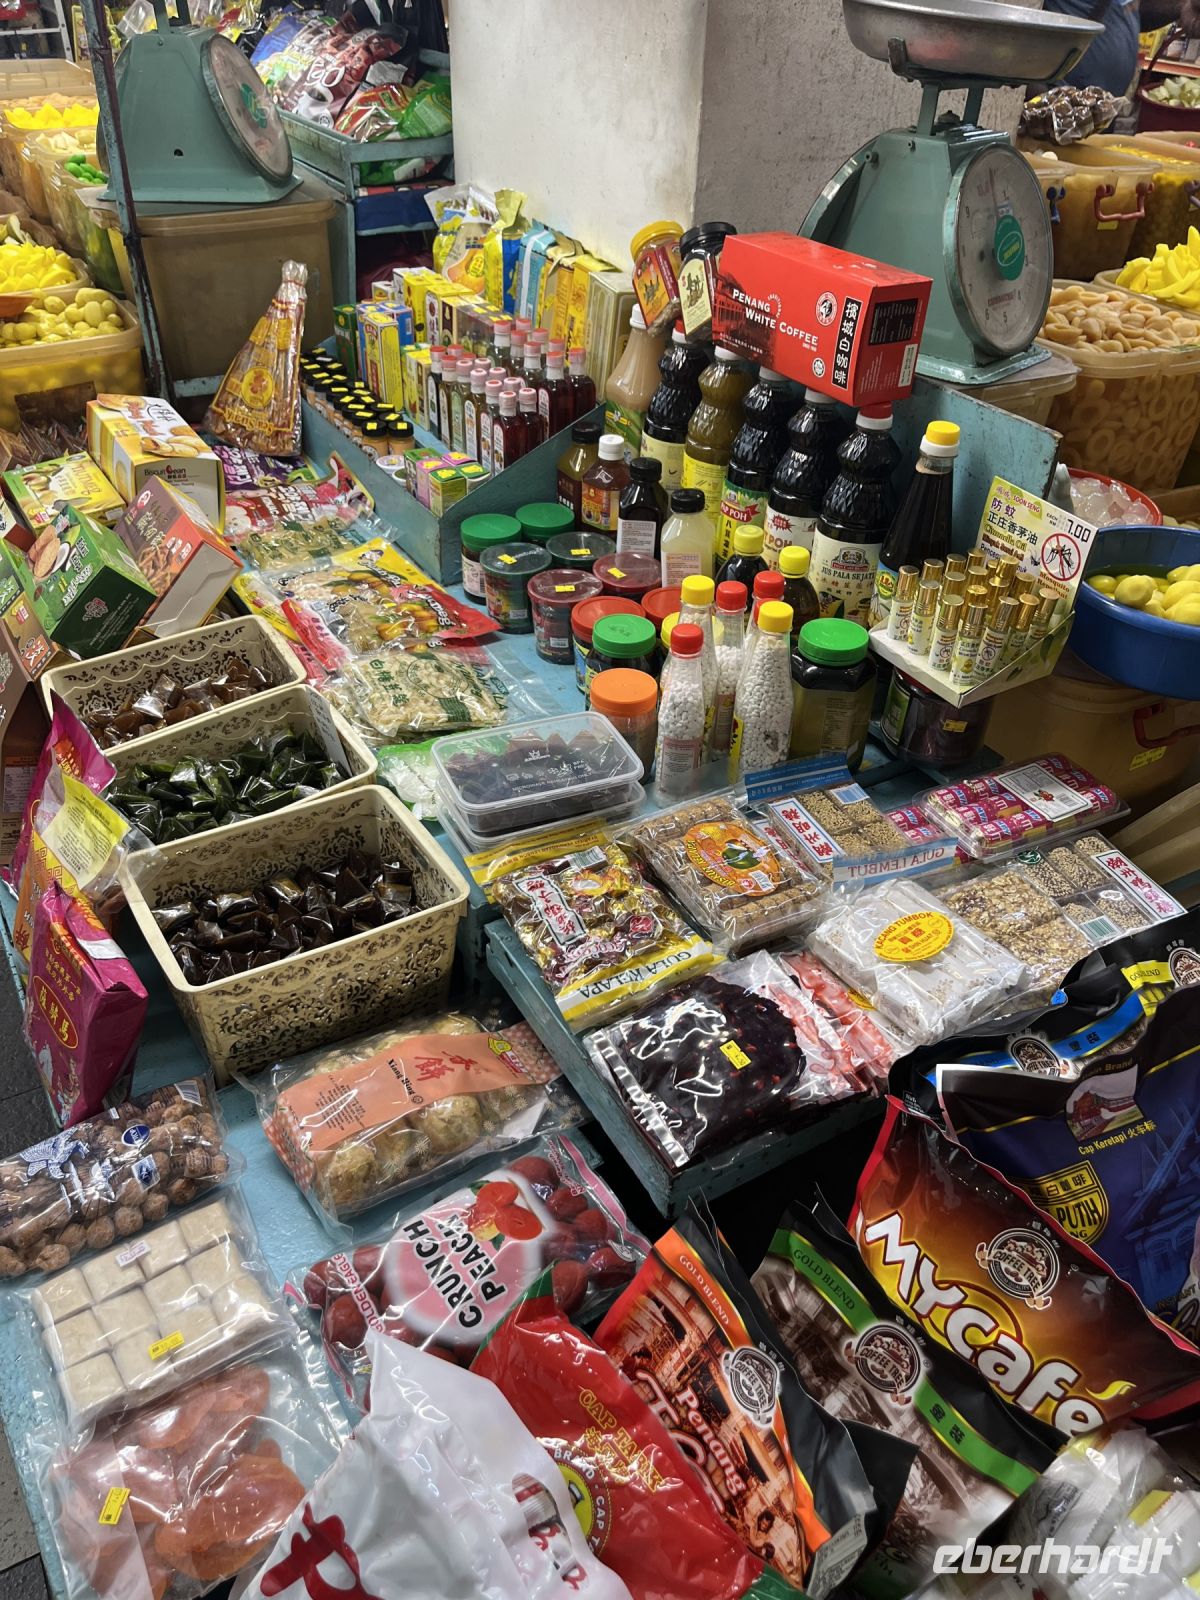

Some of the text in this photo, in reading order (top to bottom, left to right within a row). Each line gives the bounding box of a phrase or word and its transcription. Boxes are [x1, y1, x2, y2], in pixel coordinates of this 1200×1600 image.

[732, 288, 771, 312] PENANG
[745, 308, 776, 329] WHITE
[779, 322, 819, 347] COFFEE
[834, 302, 860, 385] 檳城白咖啡
[729, 508, 748, 521] POH
[991, 498, 1016, 518] 防蚊
[1013, 495, 1041, 513] SOON SENG
[987, 511, 1038, 546] 正庄香茅油
[821, 566, 832, 576] JUS
[832, 569, 850, 580] PALA
[1040, 571, 1070, 593] Mosquito
[895, 912, 933, 927] TUMBOK
[579, 951, 693, 999] GULA KELAPA
[387, 1058, 407, 1083] Xiang
[1104, 1057, 1135, 1073] Brand
[1077, 1131, 1128, 1157] Cap Keretapi
[1055, 1197, 1101, 1233] PUTIH
[402, 1218, 484, 1329] CRUNCH
[434, 1212, 507, 1302] PEACH
[992, 1247, 1041, 1293] COFFEE TREE
[332, 1251, 386, 1333] GOLDEN EAGLE
[678, 1253, 730, 1326] GOLD BLEND
[793, 1247, 855, 1312] GOLD BLEND
[732, 1359, 769, 1411] COFFEE TREE
[858, 1347, 905, 1390] COFFEE TREE
[578, 1386, 617, 1429] CAP
[673, 1384, 747, 1497] Penang
[593, 1495, 606, 1530] CAP
